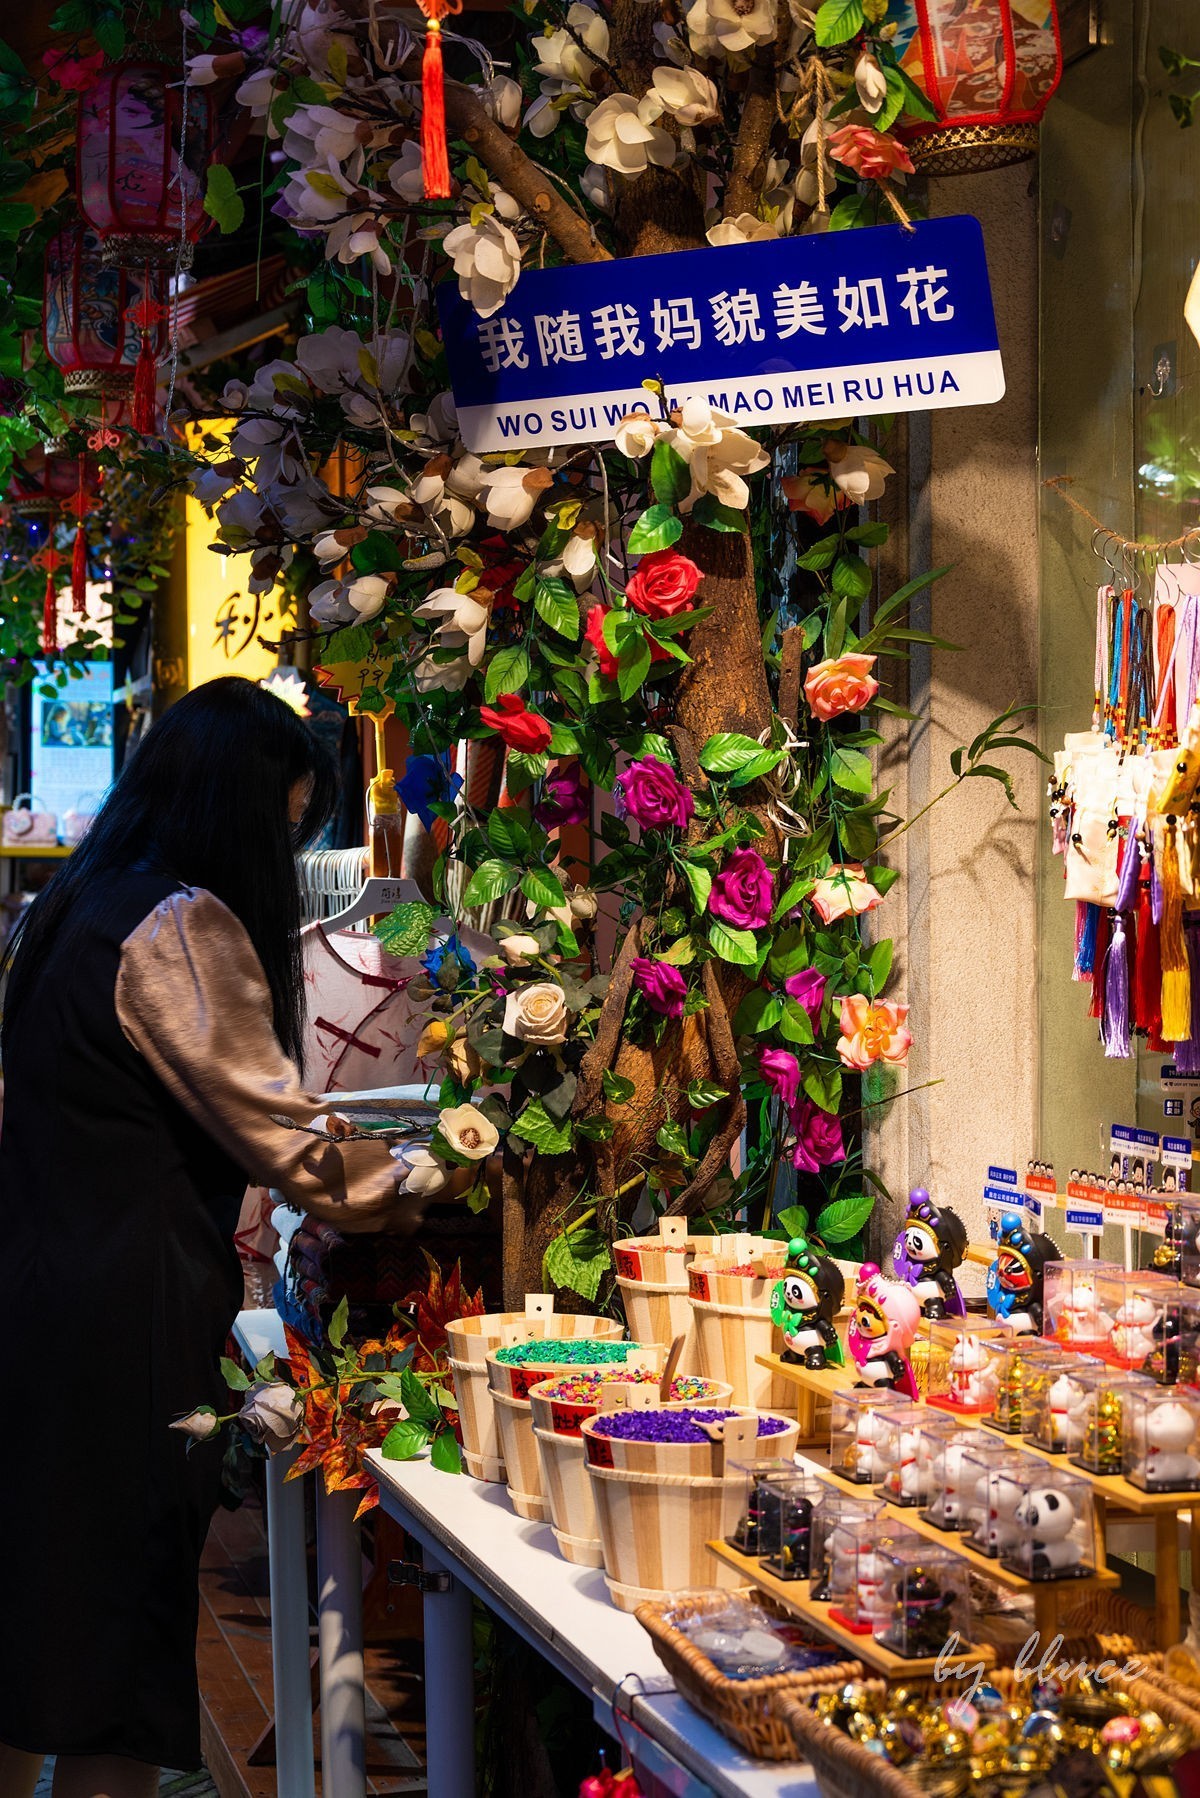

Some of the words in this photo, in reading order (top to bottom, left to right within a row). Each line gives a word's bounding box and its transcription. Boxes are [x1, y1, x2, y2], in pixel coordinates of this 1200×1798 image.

[477, 265, 955, 372] 我随我妈貌美如花
[496, 412, 543, 437] WO
[550, 407, 597, 432] SUI
[782, 382, 835, 409] MEI
[843, 377, 884, 403] RU
[893, 370, 960, 398] HUA
[212, 592, 275, 659] 秋
